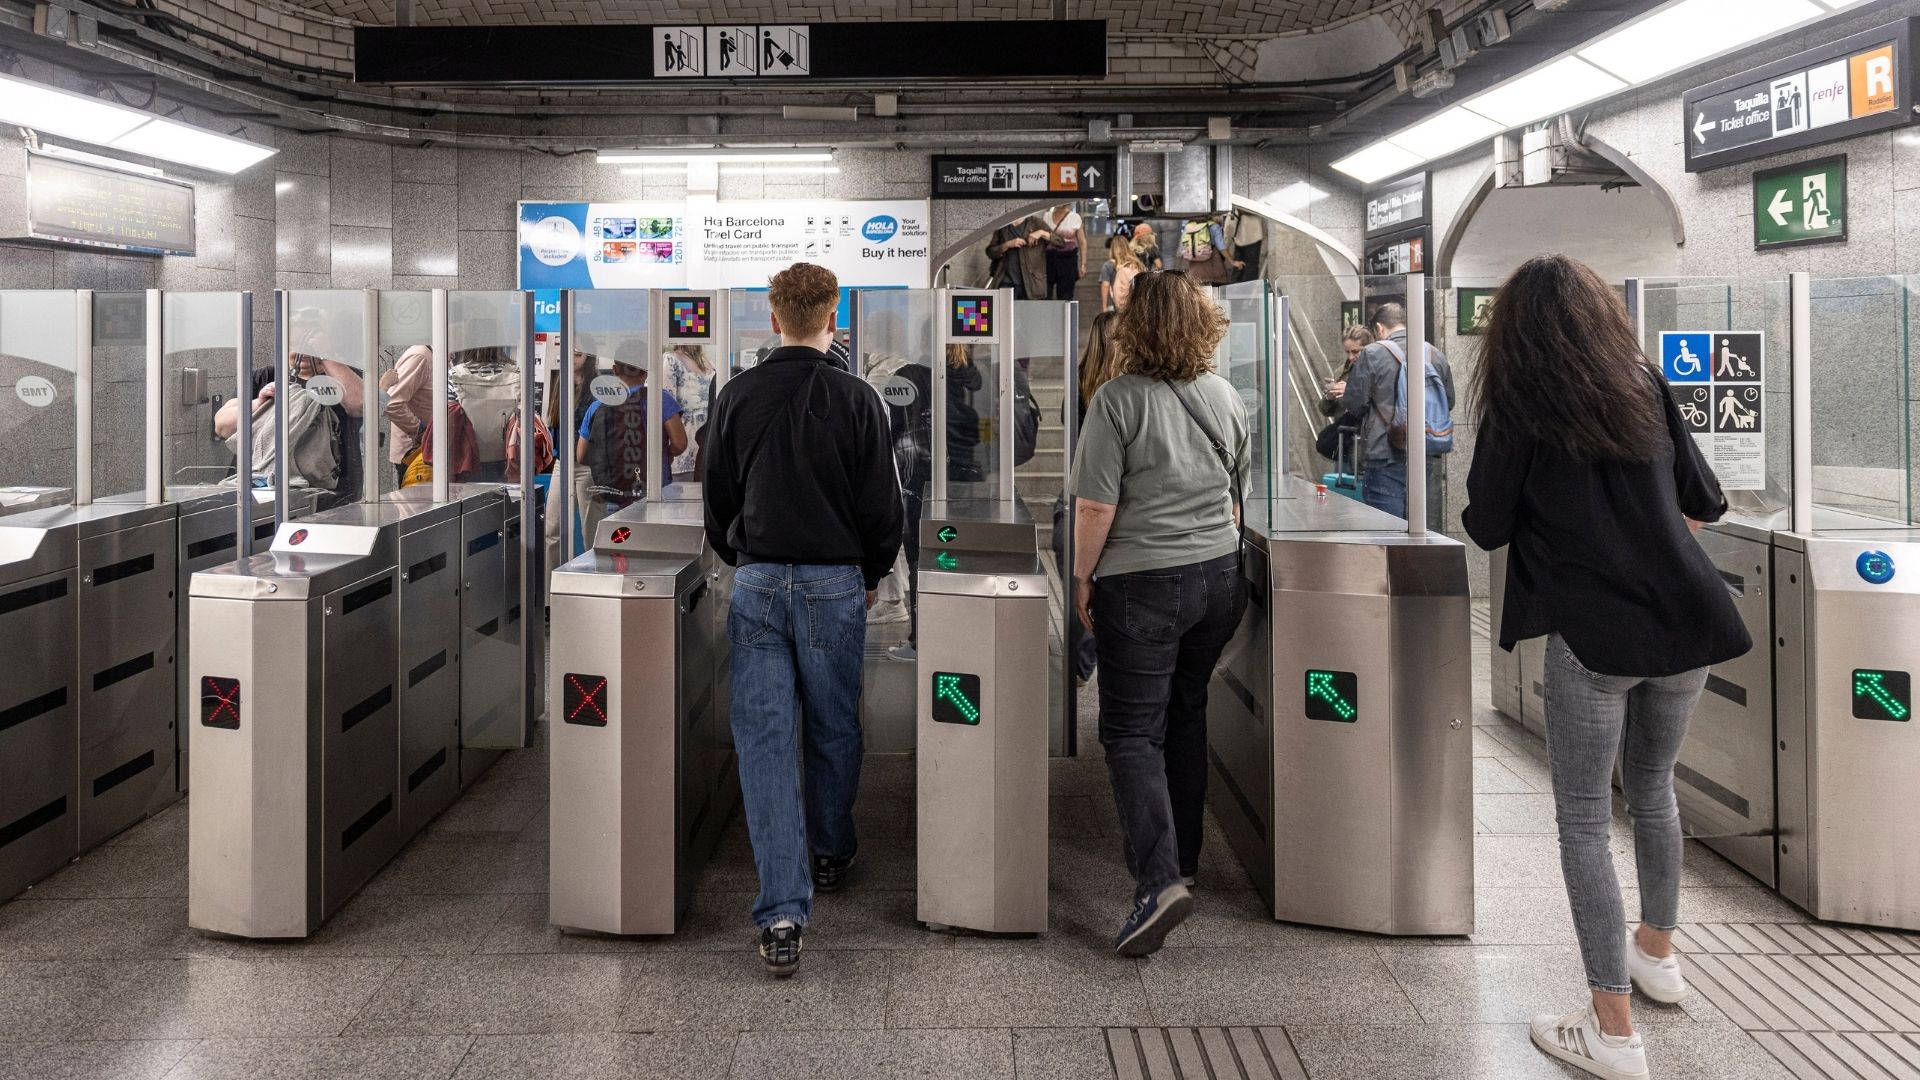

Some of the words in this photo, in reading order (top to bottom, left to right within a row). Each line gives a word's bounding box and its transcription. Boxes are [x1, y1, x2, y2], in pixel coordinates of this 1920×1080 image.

[1866, 56, 1892, 97] R
[1813, 81, 1844, 102] renfe
[1734, 92, 1769, 112] Taquilla
[1720, 115, 1744, 132] Ticket
[1745, 109, 1770, 126] office
[957, 166, 987, 176] Taquilla
[1021, 172, 1046, 181] renfe
[1061, 166, 1077, 183] R
[726, 216, 785, 227] Barcelona
[867, 221, 895, 230] HOLA
[675, 226, 683, 237] 72
[734, 229, 762, 239] Card
[675, 249, 683, 265] 120
[863, 247, 884, 260] Buy
[888, 247, 895, 257] it
[898, 247, 927, 257] here!
